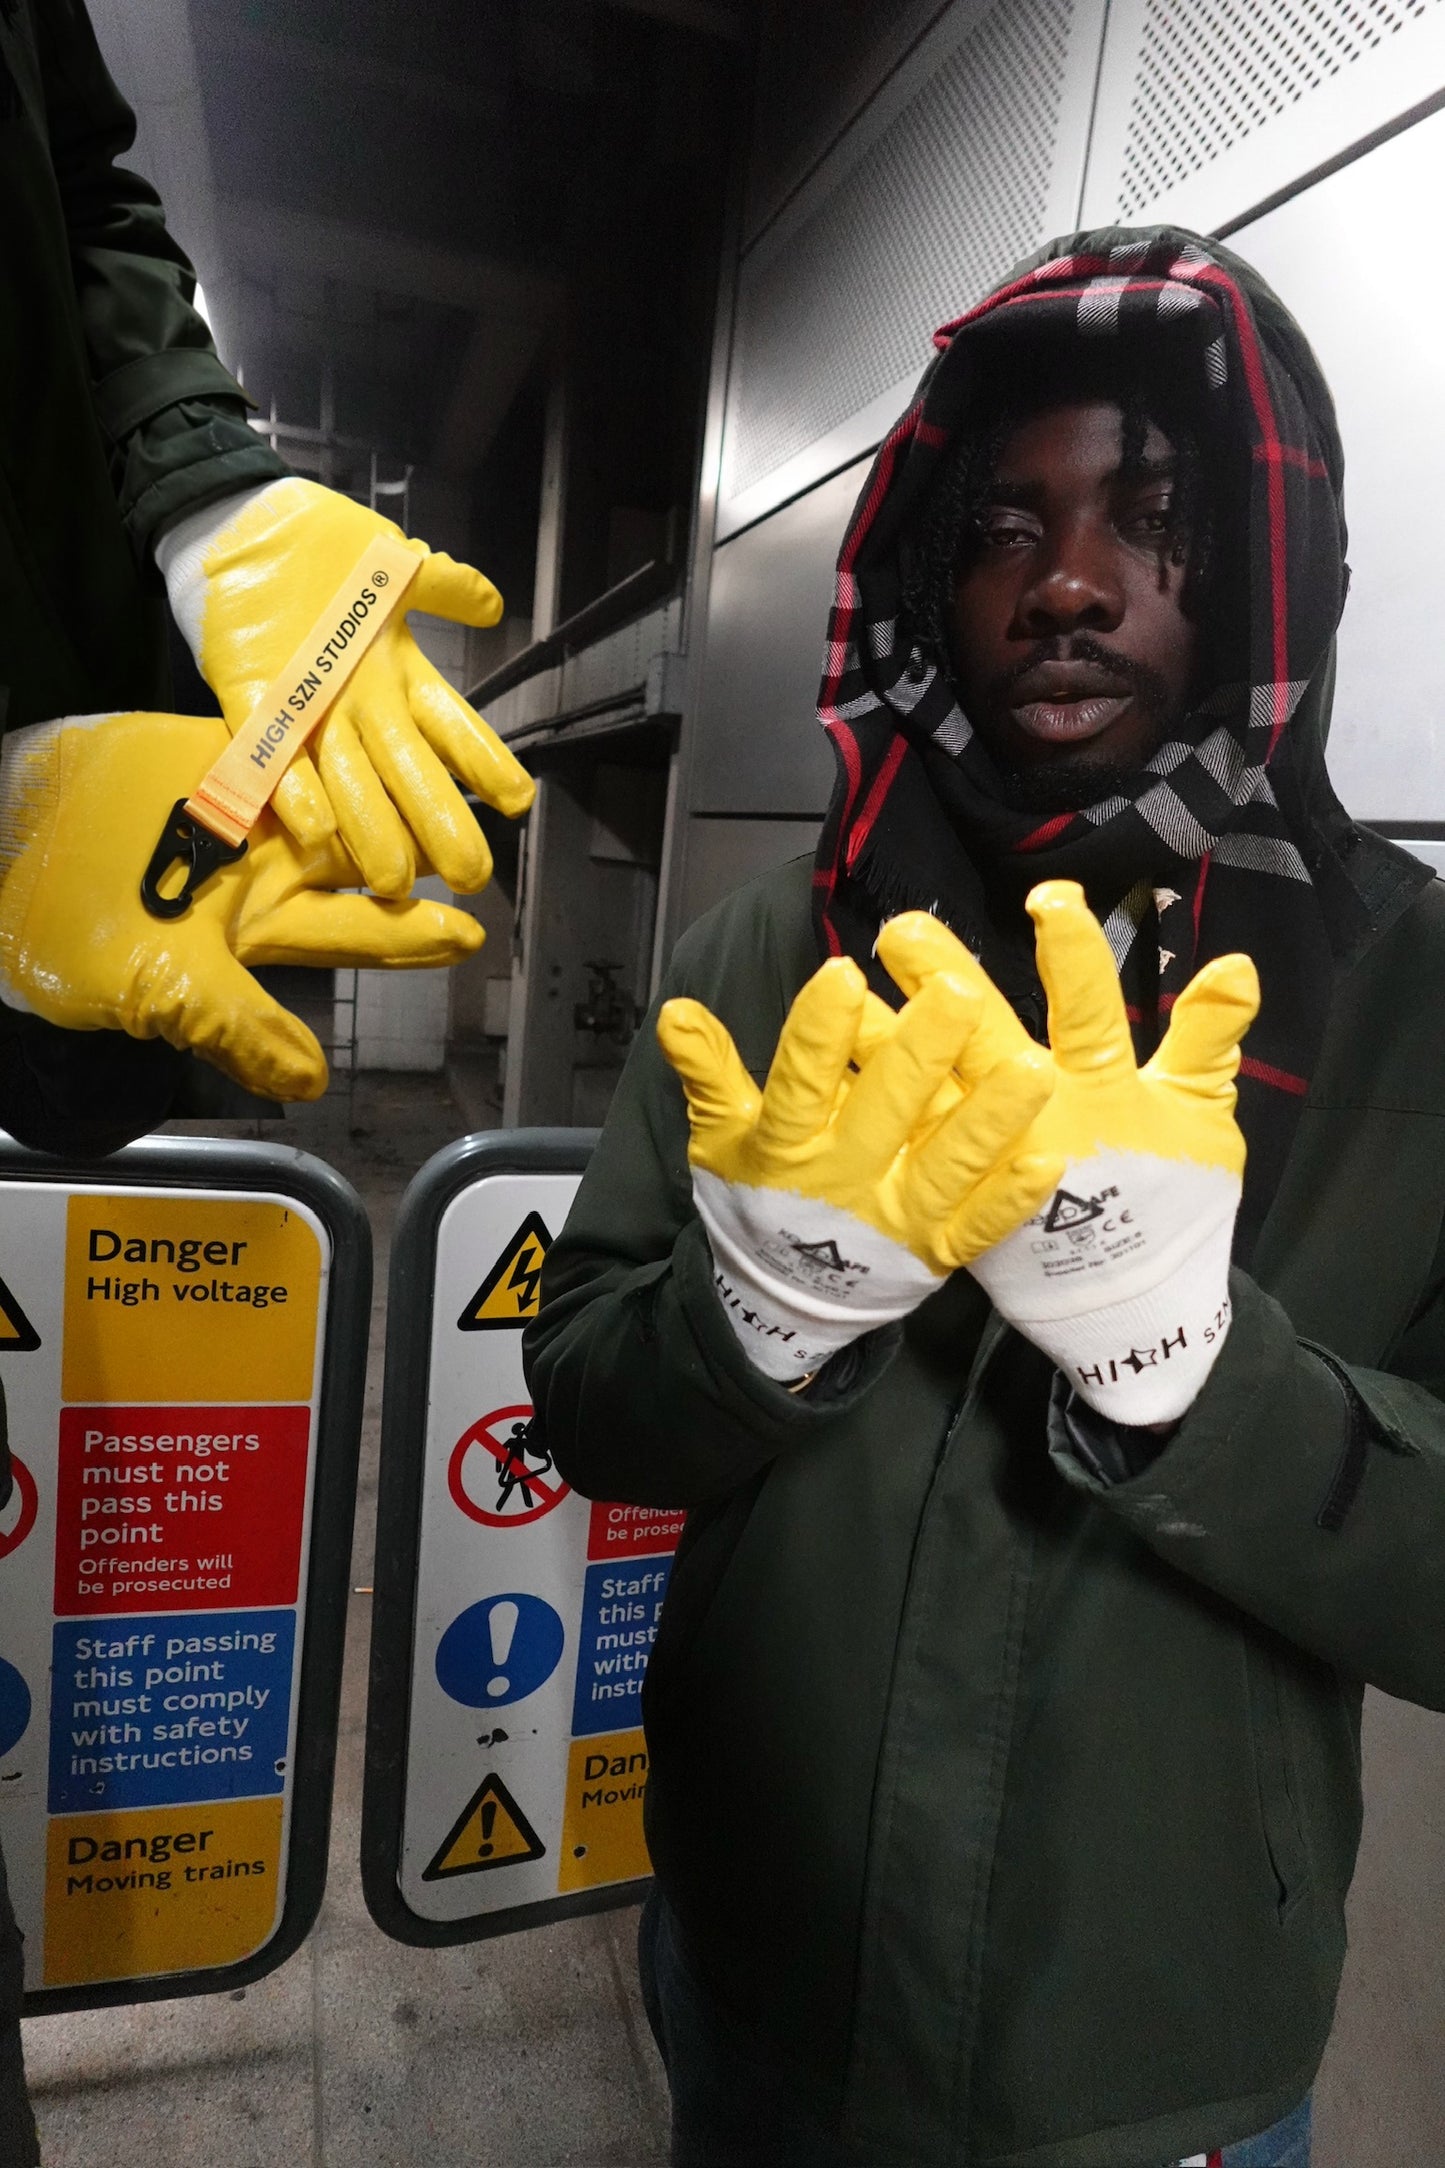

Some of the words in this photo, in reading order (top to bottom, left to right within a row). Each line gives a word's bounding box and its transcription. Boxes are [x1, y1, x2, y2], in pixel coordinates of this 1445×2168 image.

[250, 708, 295, 769] HIGH
[288, 670, 323, 711] SZN
[88, 1229, 247, 1272] Danger
[87, 1277, 160, 1306] High
[173, 1280, 288, 1308] voltage
[84, 1430, 260, 1456] Passengers
[82, 1462, 164, 1484] must
[176, 1462, 229, 1483] not
[81, 1496, 152, 1520] pass
[164, 1490, 224, 1512] this
[80, 1523, 163, 1550] point
[606, 1527, 627, 1541] be
[78, 1557, 189, 1575] Offenders
[197, 1555, 233, 1570] will
[78, 1579, 104, 1594] be
[112, 1575, 231, 1596] prosecuted
[601, 1573, 665, 1598] Staff
[599, 1601, 645, 1625] this
[75, 1634, 155, 1660] Staff
[166, 1630, 277, 1659] passing
[596, 1626, 658, 1650] must
[74, 1667, 133, 1689] this
[145, 1660, 224, 1690] point
[594, 1651, 648, 1676] with
[73, 1696, 151, 1718] must
[163, 1685, 270, 1713] comply
[71, 1722, 141, 1747] with
[153, 1716, 249, 1741] safety
[71, 1743, 253, 1775] instructions
[584, 1752, 649, 1781] Dan
[68, 1830, 214, 1865] Danger
[67, 1872, 172, 1895] Moving
[184, 1858, 265, 1882] trains
